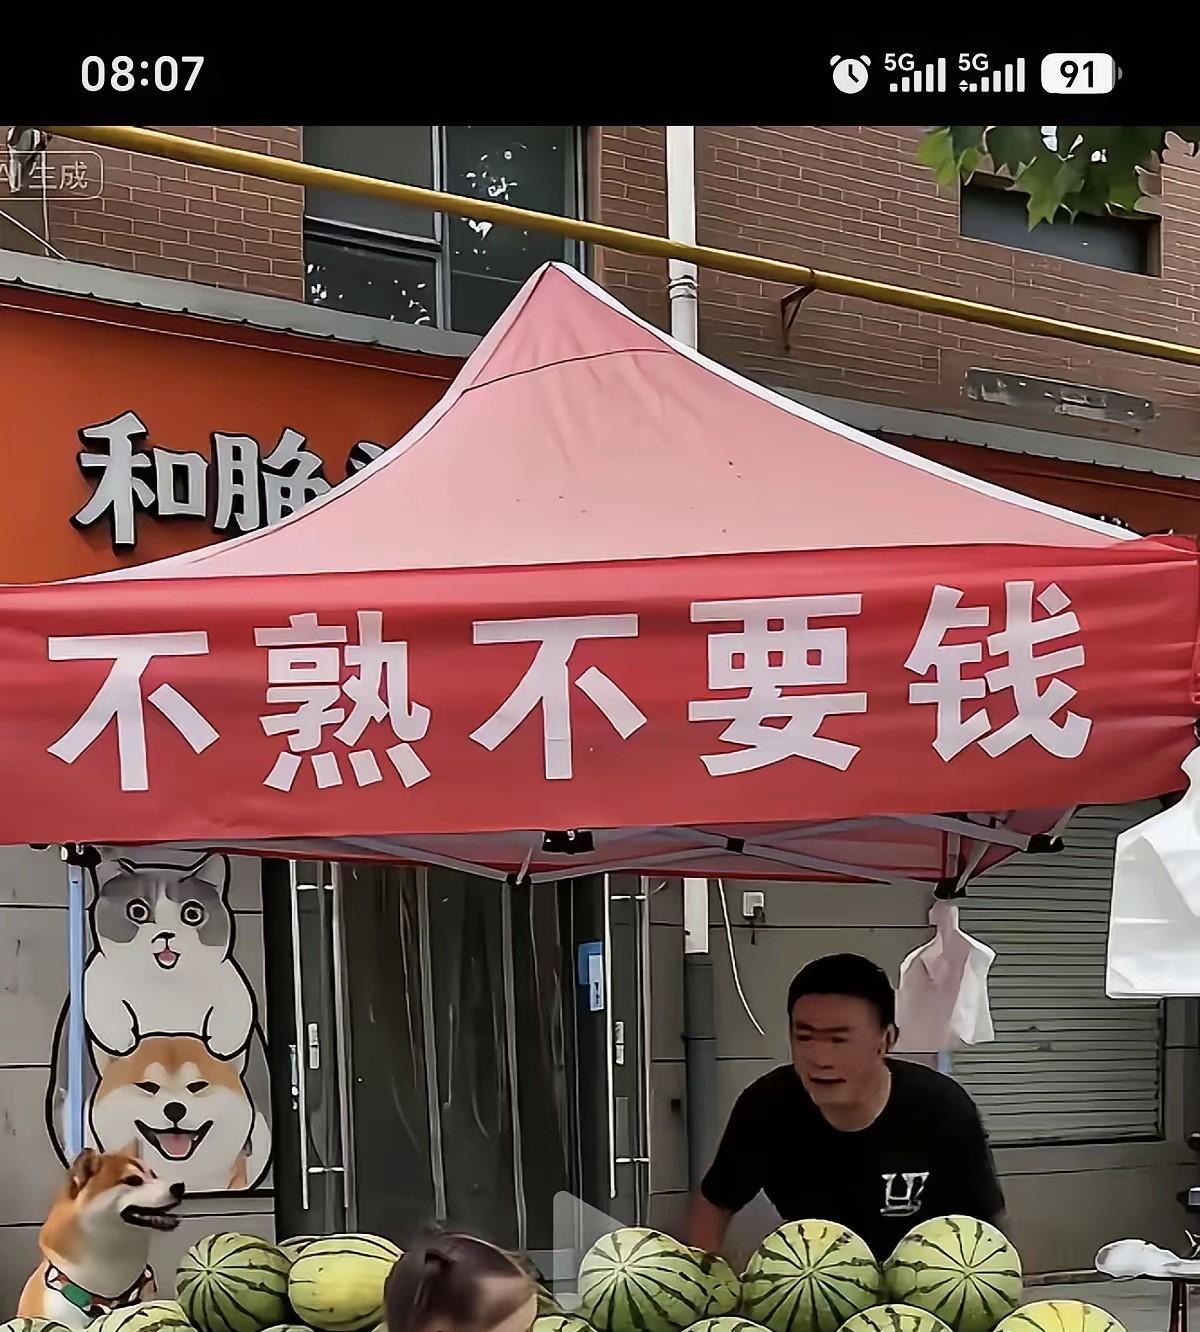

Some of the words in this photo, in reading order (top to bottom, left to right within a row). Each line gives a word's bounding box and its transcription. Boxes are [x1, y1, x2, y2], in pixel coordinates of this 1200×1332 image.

[47, 580, 1092, 792] 不熟不要钱
